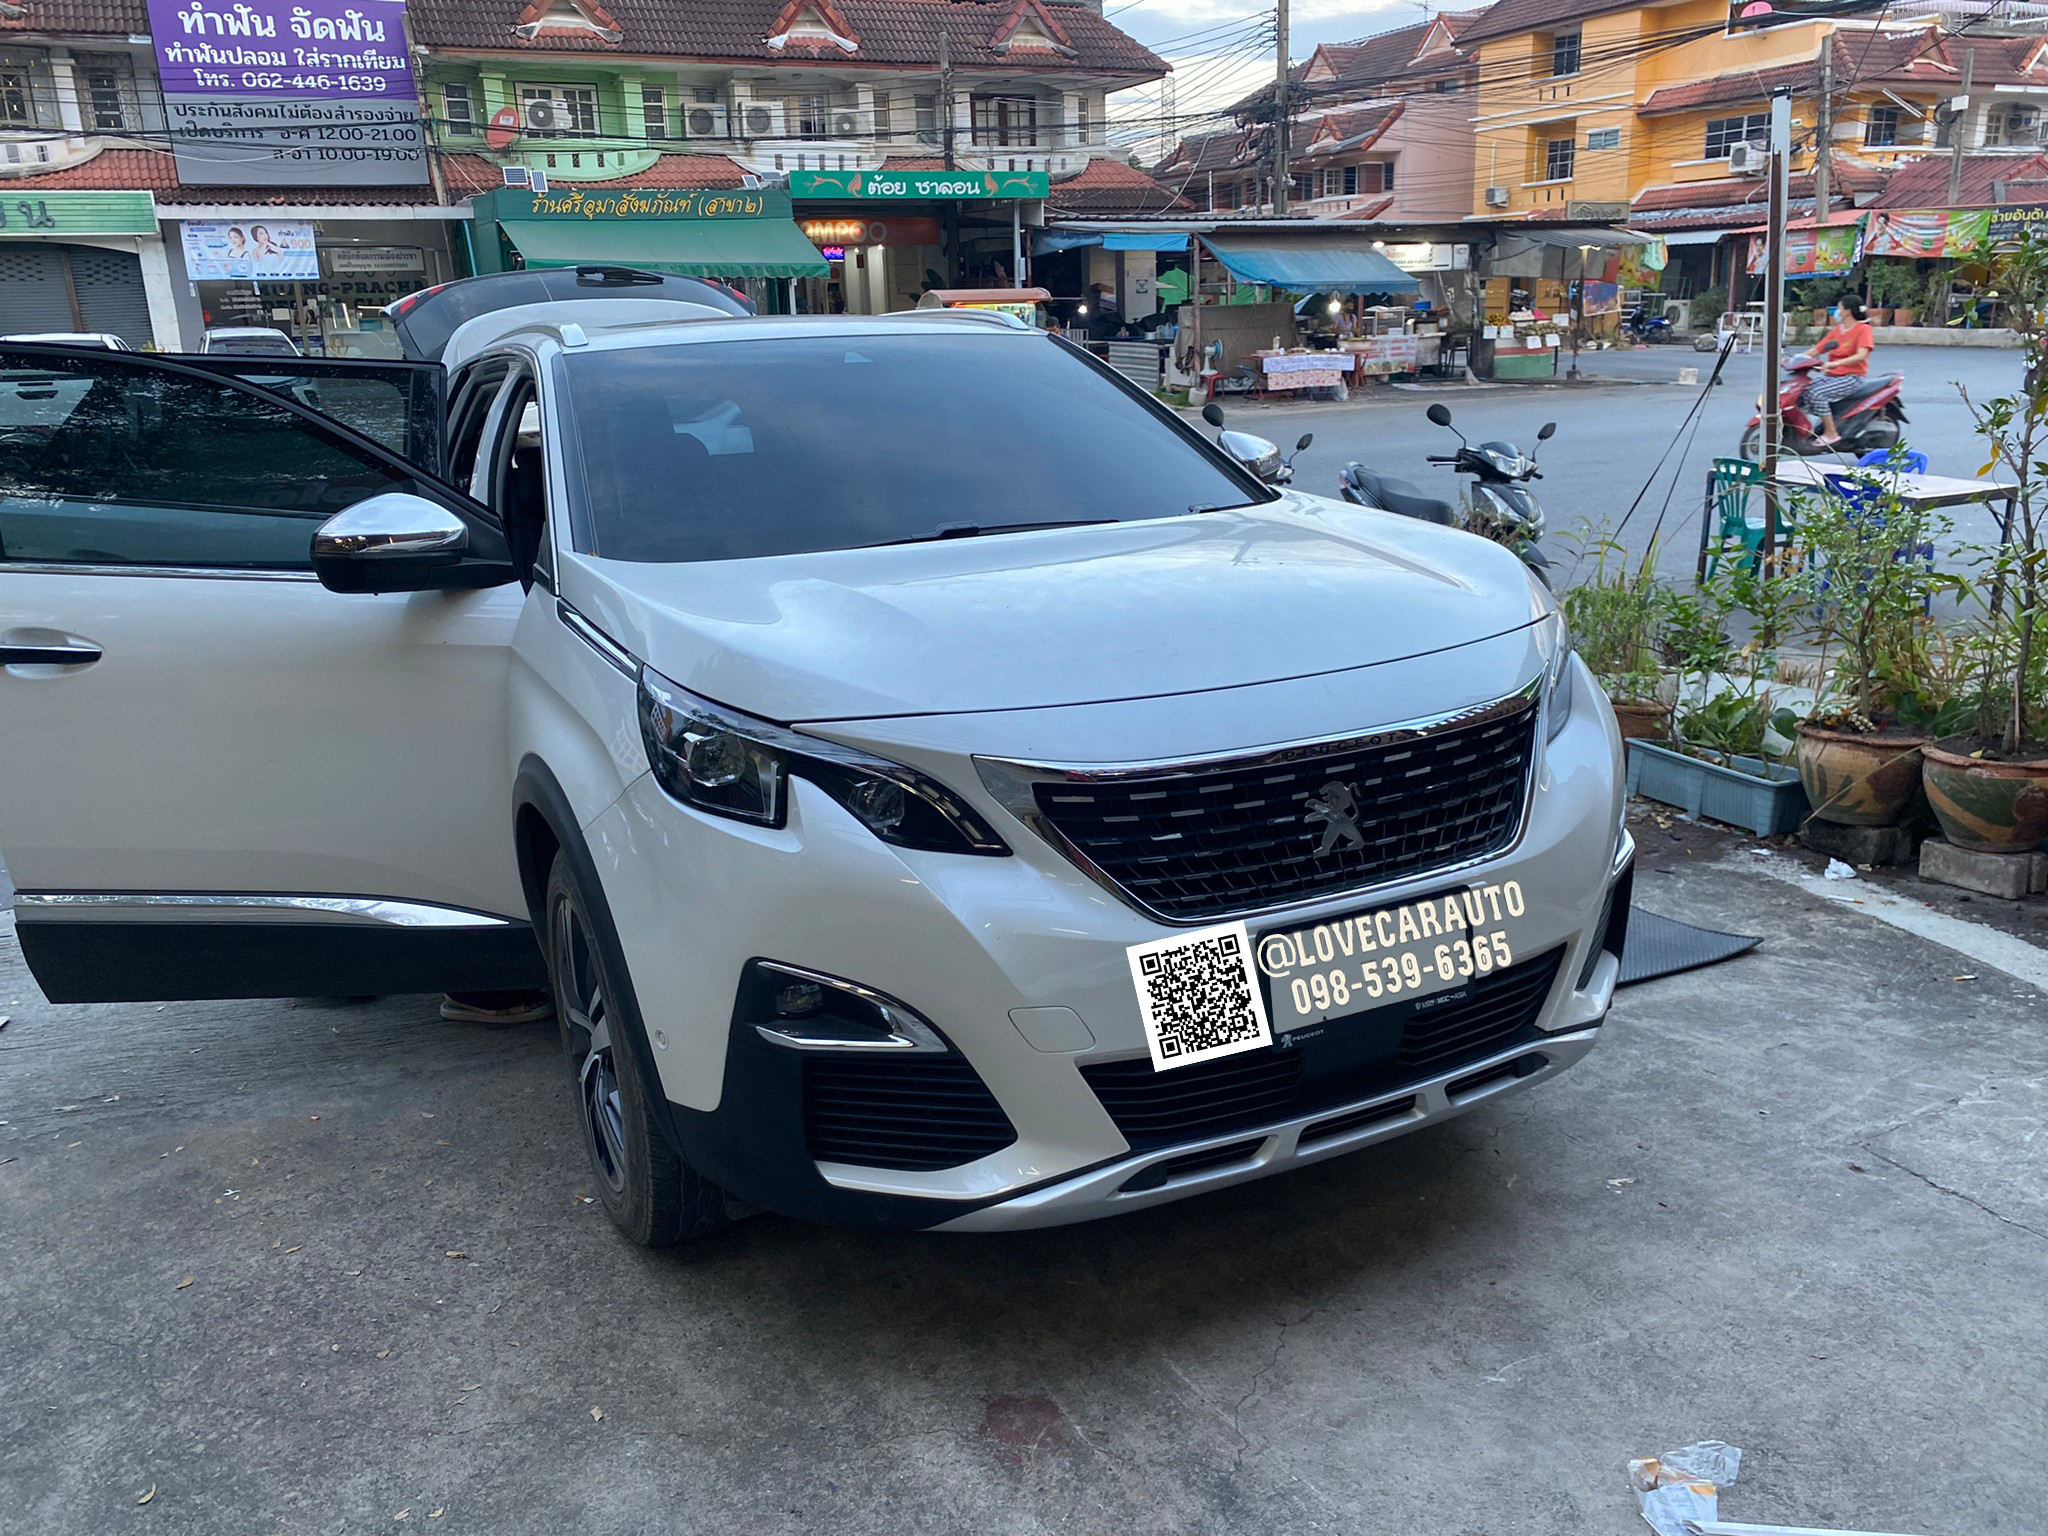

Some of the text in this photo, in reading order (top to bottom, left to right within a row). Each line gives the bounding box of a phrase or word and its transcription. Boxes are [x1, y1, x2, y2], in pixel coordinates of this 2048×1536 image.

[178, 2, 386, 42] ทำฟัน จัดฟัน
[165, 42, 406, 71] ทำฟันปลอม ใส่รากเทียม
[193, 68, 387, 92] โทร. 062-446-1639
[317, 127, 417, 142] 12.00-21.00
[867, 174, 981, 196] ต้อย ซาลอน
[1292, 1029, 1325, 1042] PEUGEOT
